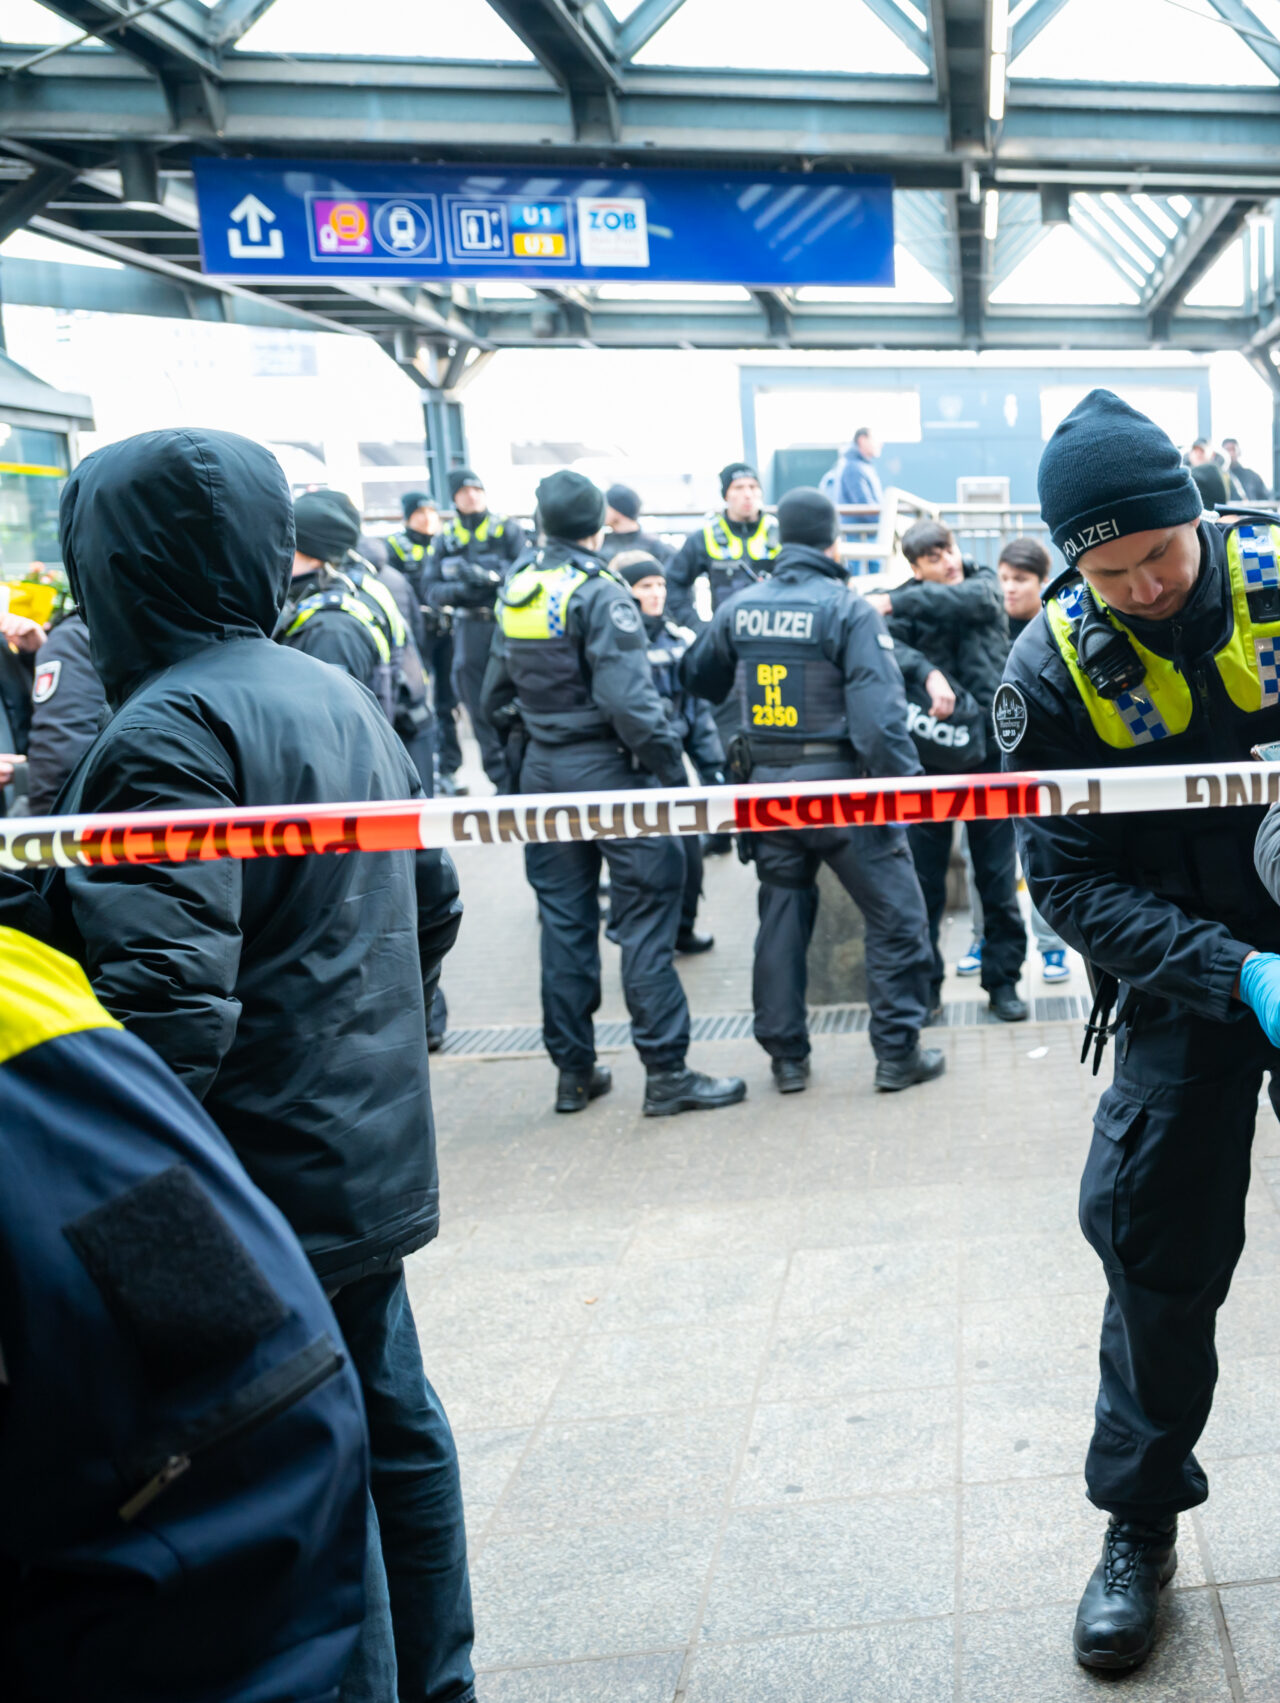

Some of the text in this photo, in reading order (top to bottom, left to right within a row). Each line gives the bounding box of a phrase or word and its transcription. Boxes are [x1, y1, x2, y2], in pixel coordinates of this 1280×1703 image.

[522, 205, 552, 227] U1
[588, 211, 637, 230] ZOB
[735, 608, 814, 639] POLIZEI
[756, 663, 788, 686] BP
[764, 685, 782, 706] H
[751, 704, 799, 727] 2350
